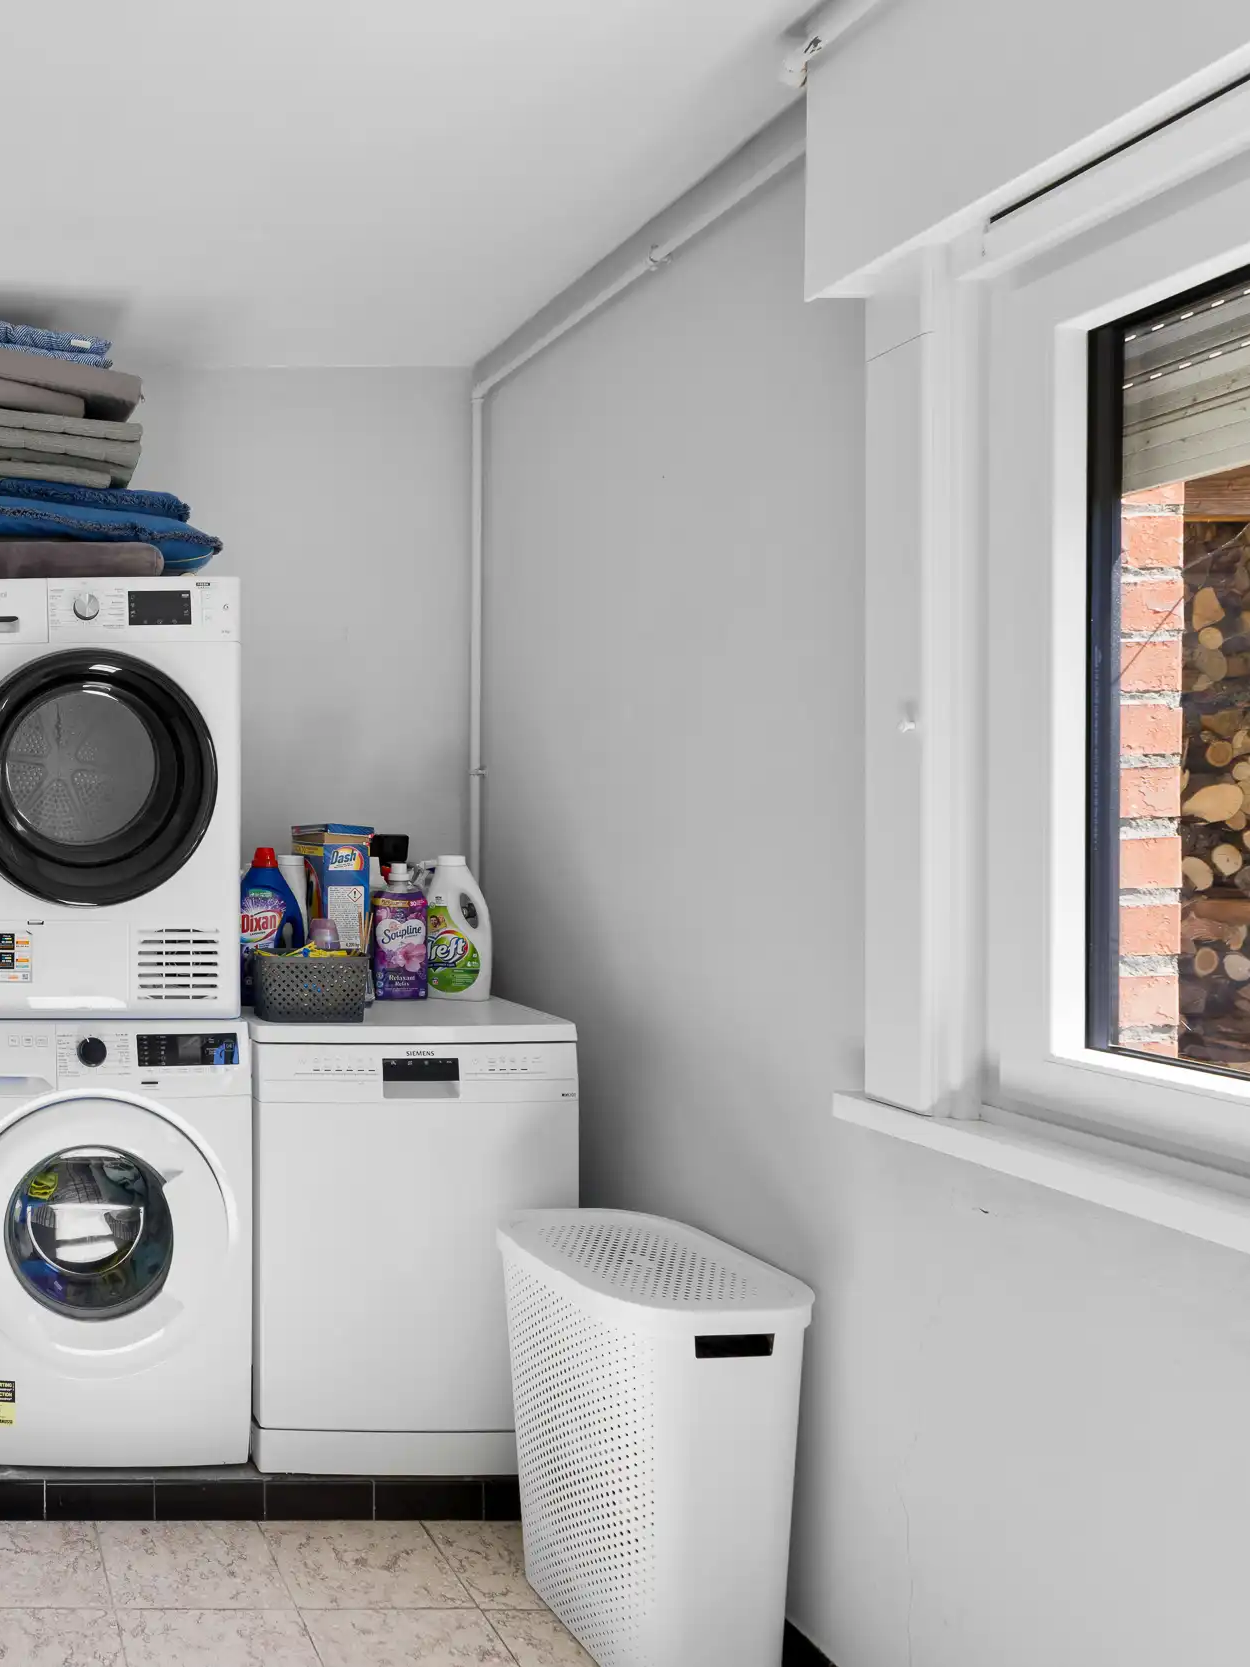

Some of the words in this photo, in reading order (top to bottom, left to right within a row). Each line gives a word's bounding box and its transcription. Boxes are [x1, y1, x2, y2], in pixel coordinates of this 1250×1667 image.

[331, 849, 357, 864] Dash
[241, 914, 277, 934] Dixan
[382, 925, 422, 944] Soupline
